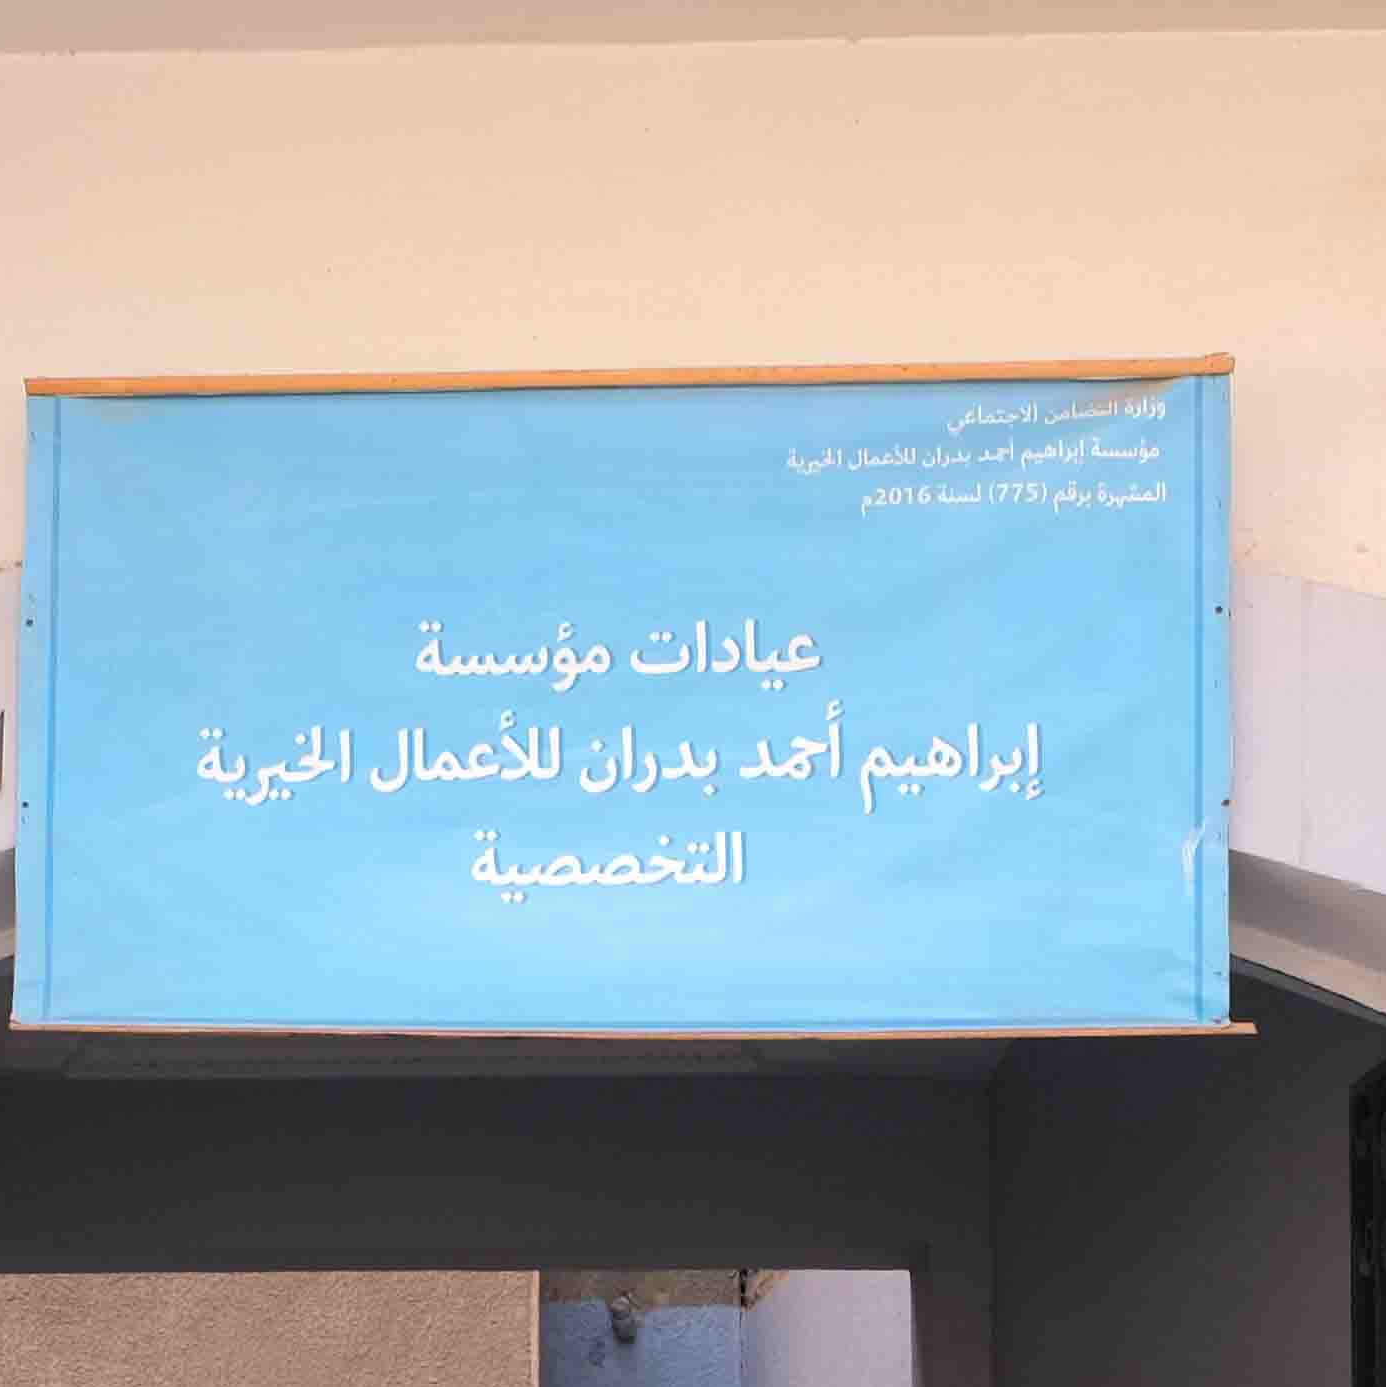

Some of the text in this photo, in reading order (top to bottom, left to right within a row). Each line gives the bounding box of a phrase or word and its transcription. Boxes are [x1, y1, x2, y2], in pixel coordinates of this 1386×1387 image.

[947, 402, 1039, 434] الاجتماعي
[1123, 394, 1167, 419] وزارة
[787, 445, 843, 476] الخيرية
[922, 446, 971, 469] بدران
[1090, 436, 1161, 465] مؤسسة
[937, 483, 982, 506] لسنة
[988, 481, 1048, 506] (775)
[1052, 480, 1093, 513] برقم
[1097, 481, 1167, 510] المشهرة
[415, 617, 822, 693] عيادات مؤسسة
[195, 699, 1042, 815] إبراهيم أحمد بدران للأعمال الخيرية
[470, 829, 744, 905] التخصصية
